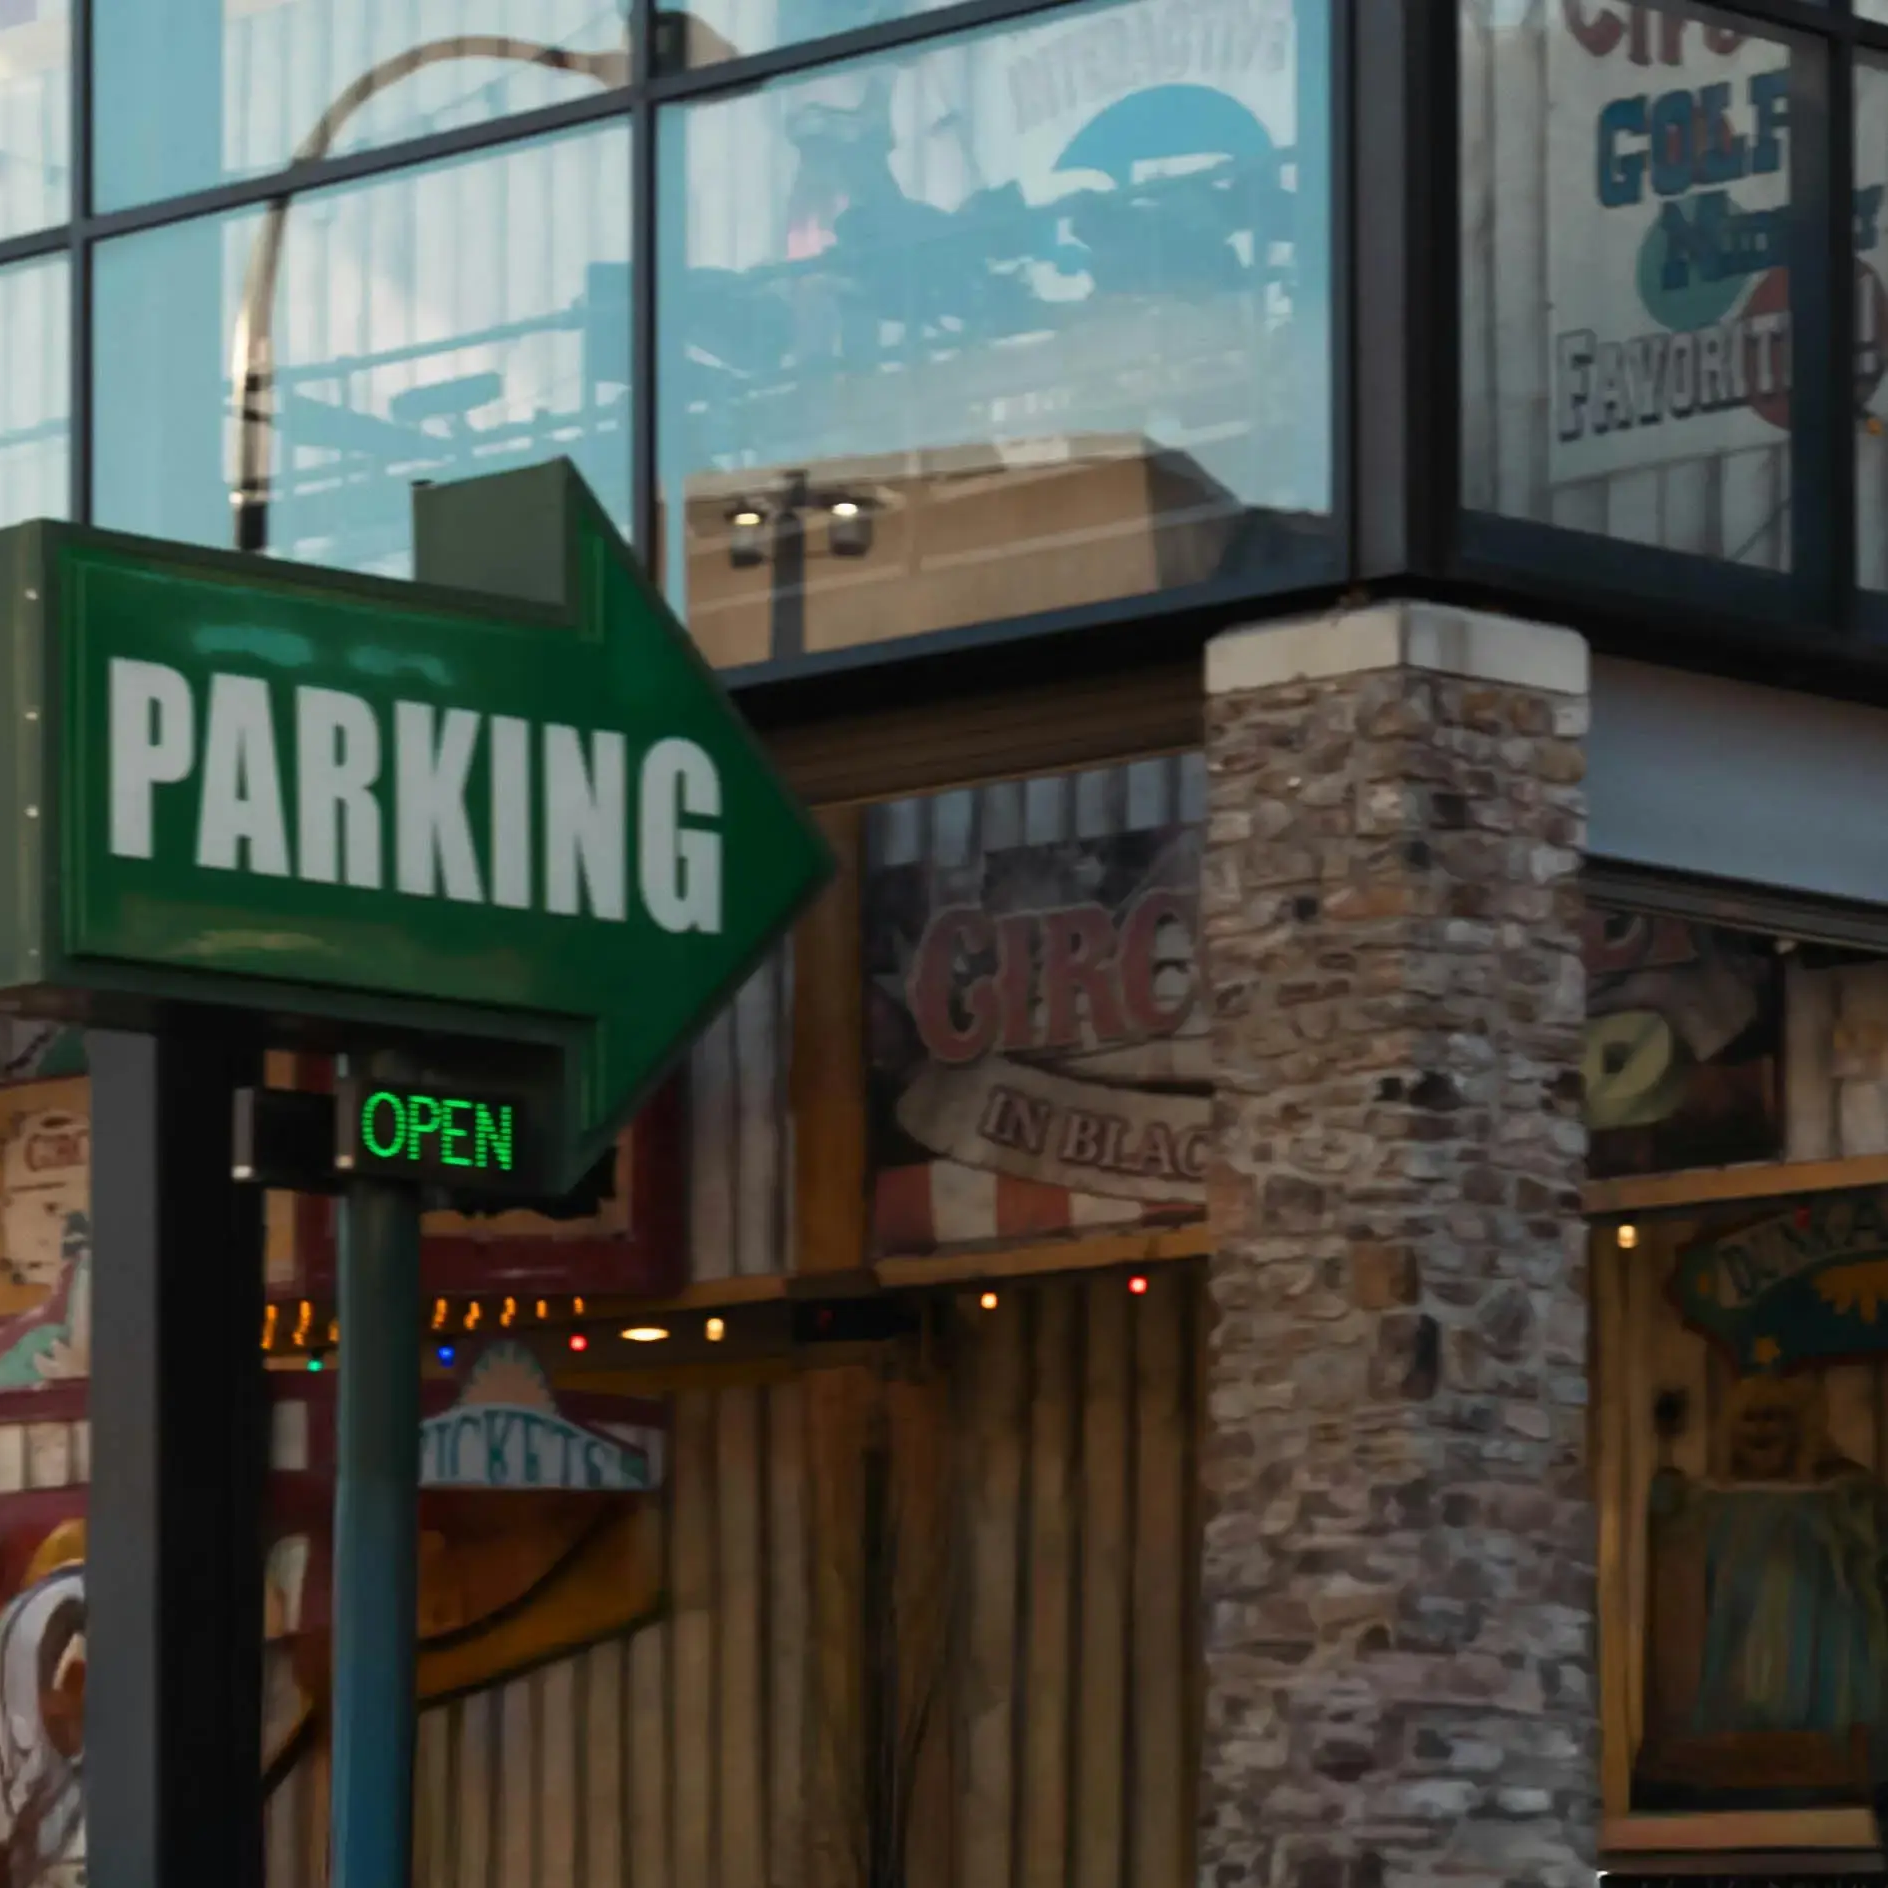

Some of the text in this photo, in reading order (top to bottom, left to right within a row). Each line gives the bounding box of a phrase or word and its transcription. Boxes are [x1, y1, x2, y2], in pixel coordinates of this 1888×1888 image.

[1597, 69, 1790, 208] GOLF
[1556, 312, 1790, 443] FAVORIT
[107, 656, 723, 935] PARKING
[360, 1090, 513, 1171] OPEN
[980, 1085, 1050, 1153] IN
